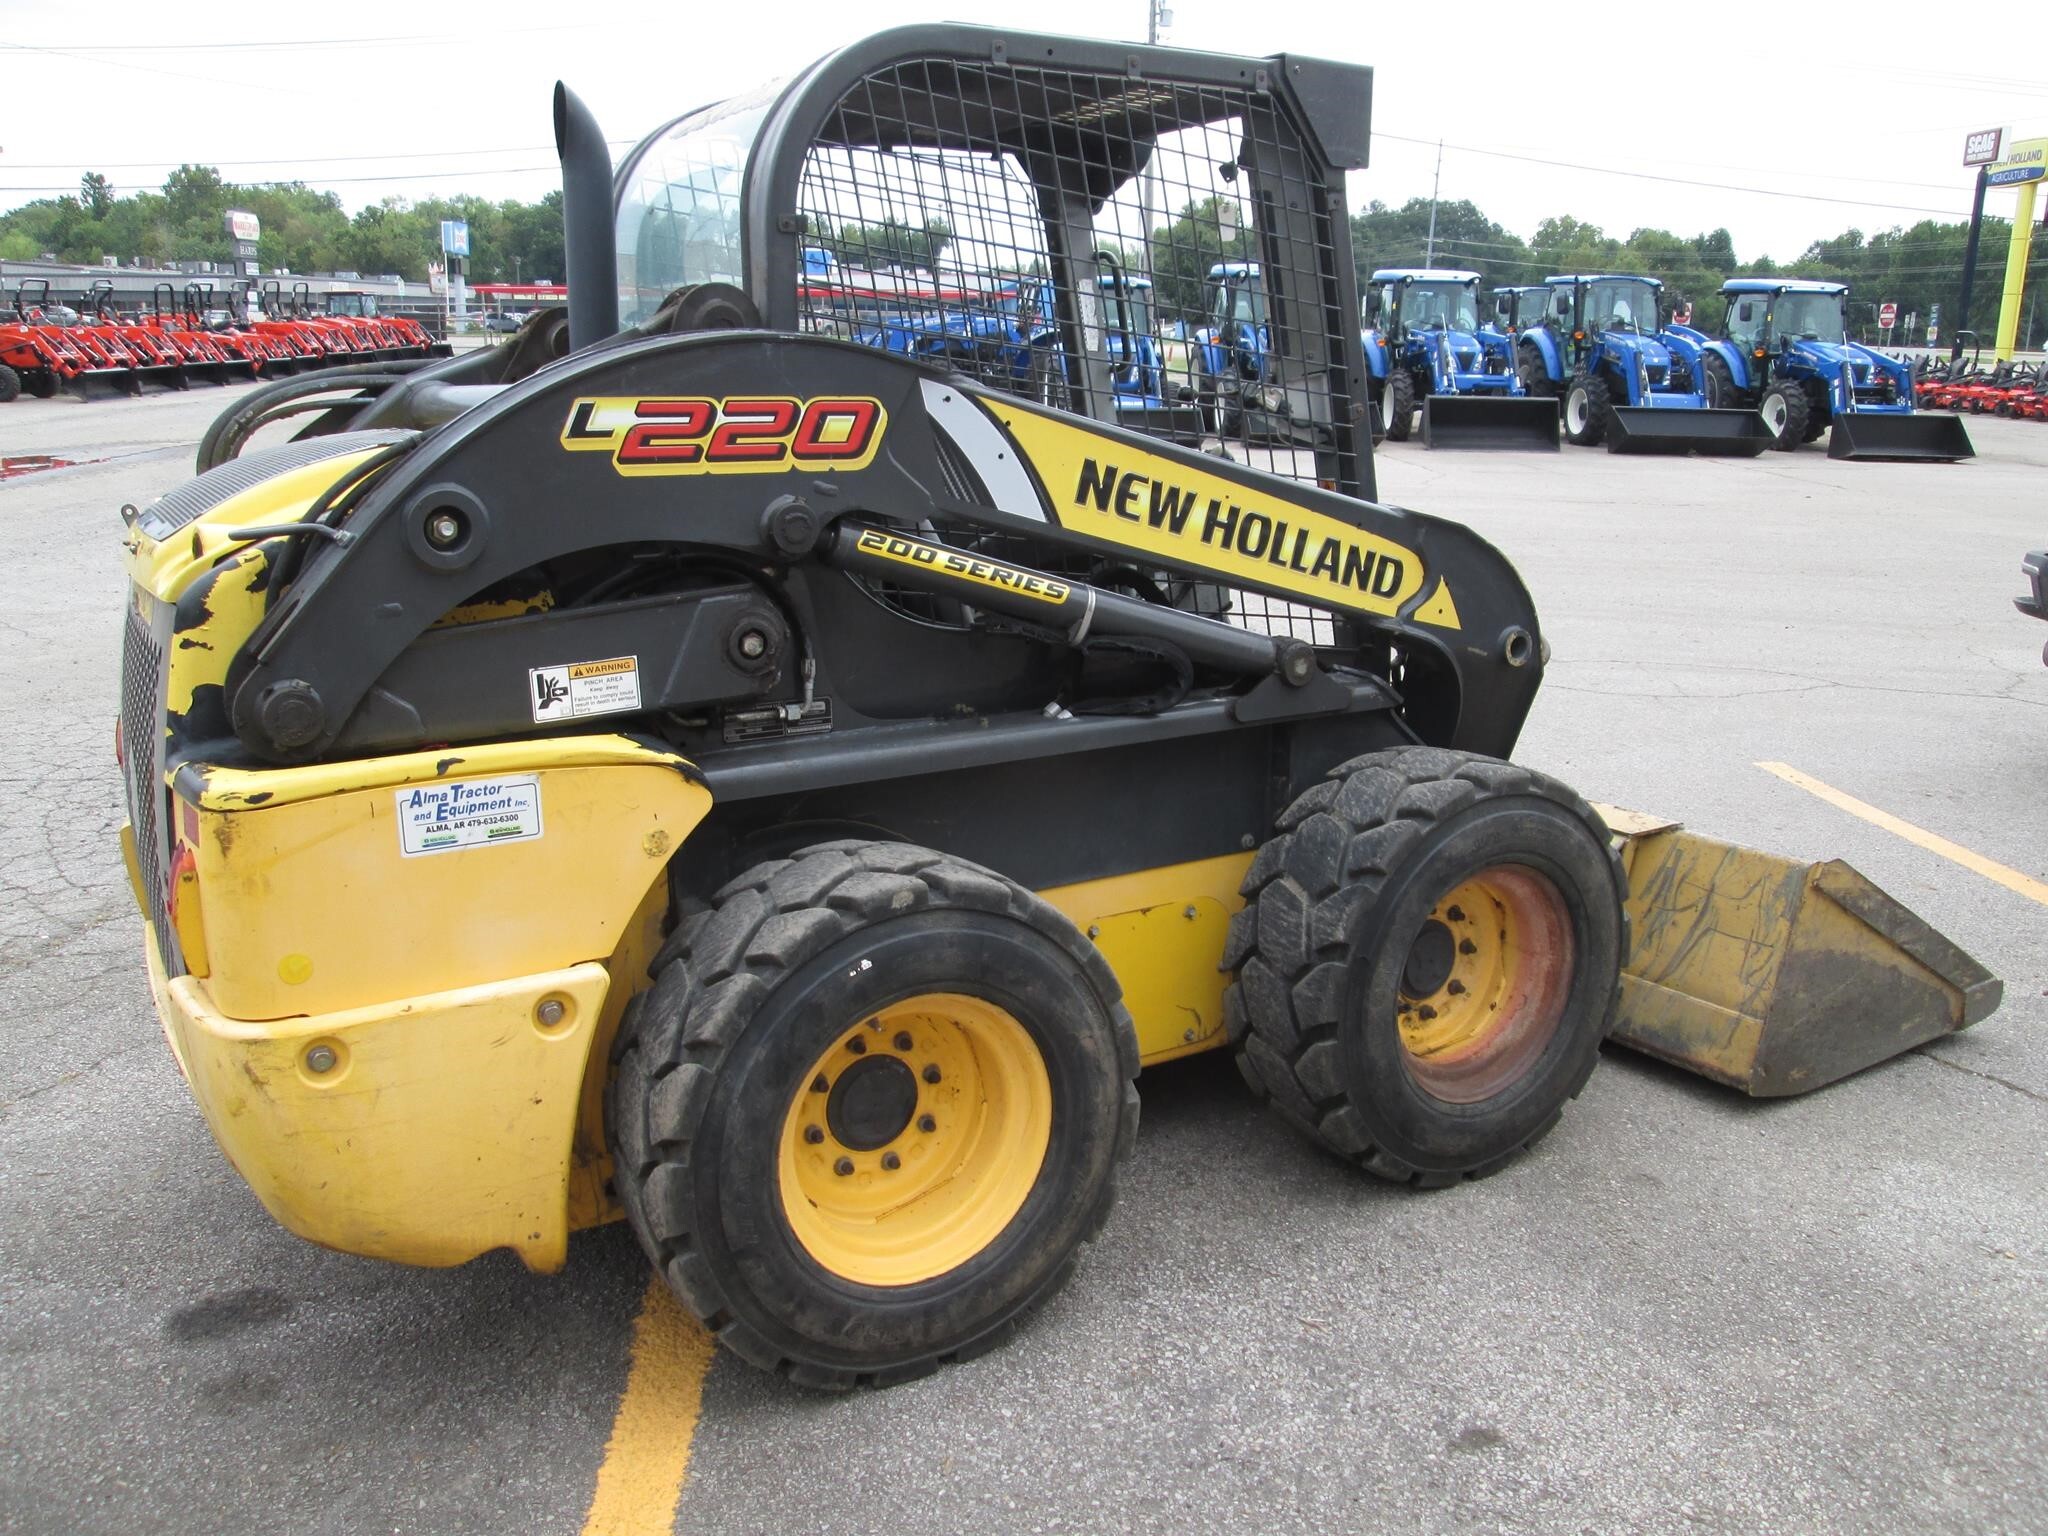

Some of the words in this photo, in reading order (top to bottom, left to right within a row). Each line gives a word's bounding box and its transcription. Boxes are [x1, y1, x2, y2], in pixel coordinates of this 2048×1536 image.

[1968, 132, 1995, 153] SCAG
[2009, 150, 2043, 165] HOLLAND
[1991, 168, 2030, 183] AGRICULTURE
[566, 399, 882, 465] L220
[1074, 457, 1197, 535] NEW
[1200, 498, 1404, 600] HOLLAND
[860, 531, 938, 564] 200
[944, 554, 1067, 600] SERIES
[585, 661, 631, 674] WARNING
[409, 789, 448, 809] Alma
[450, 784, 504, 803] Tractor
[414, 811, 432, 822] and
[436, 798, 512, 822] Equipment
[426, 822, 452, 834] ALMA,
[453, 821, 466, 830] AR
[467, 813, 519, 828] 479-632-6300
